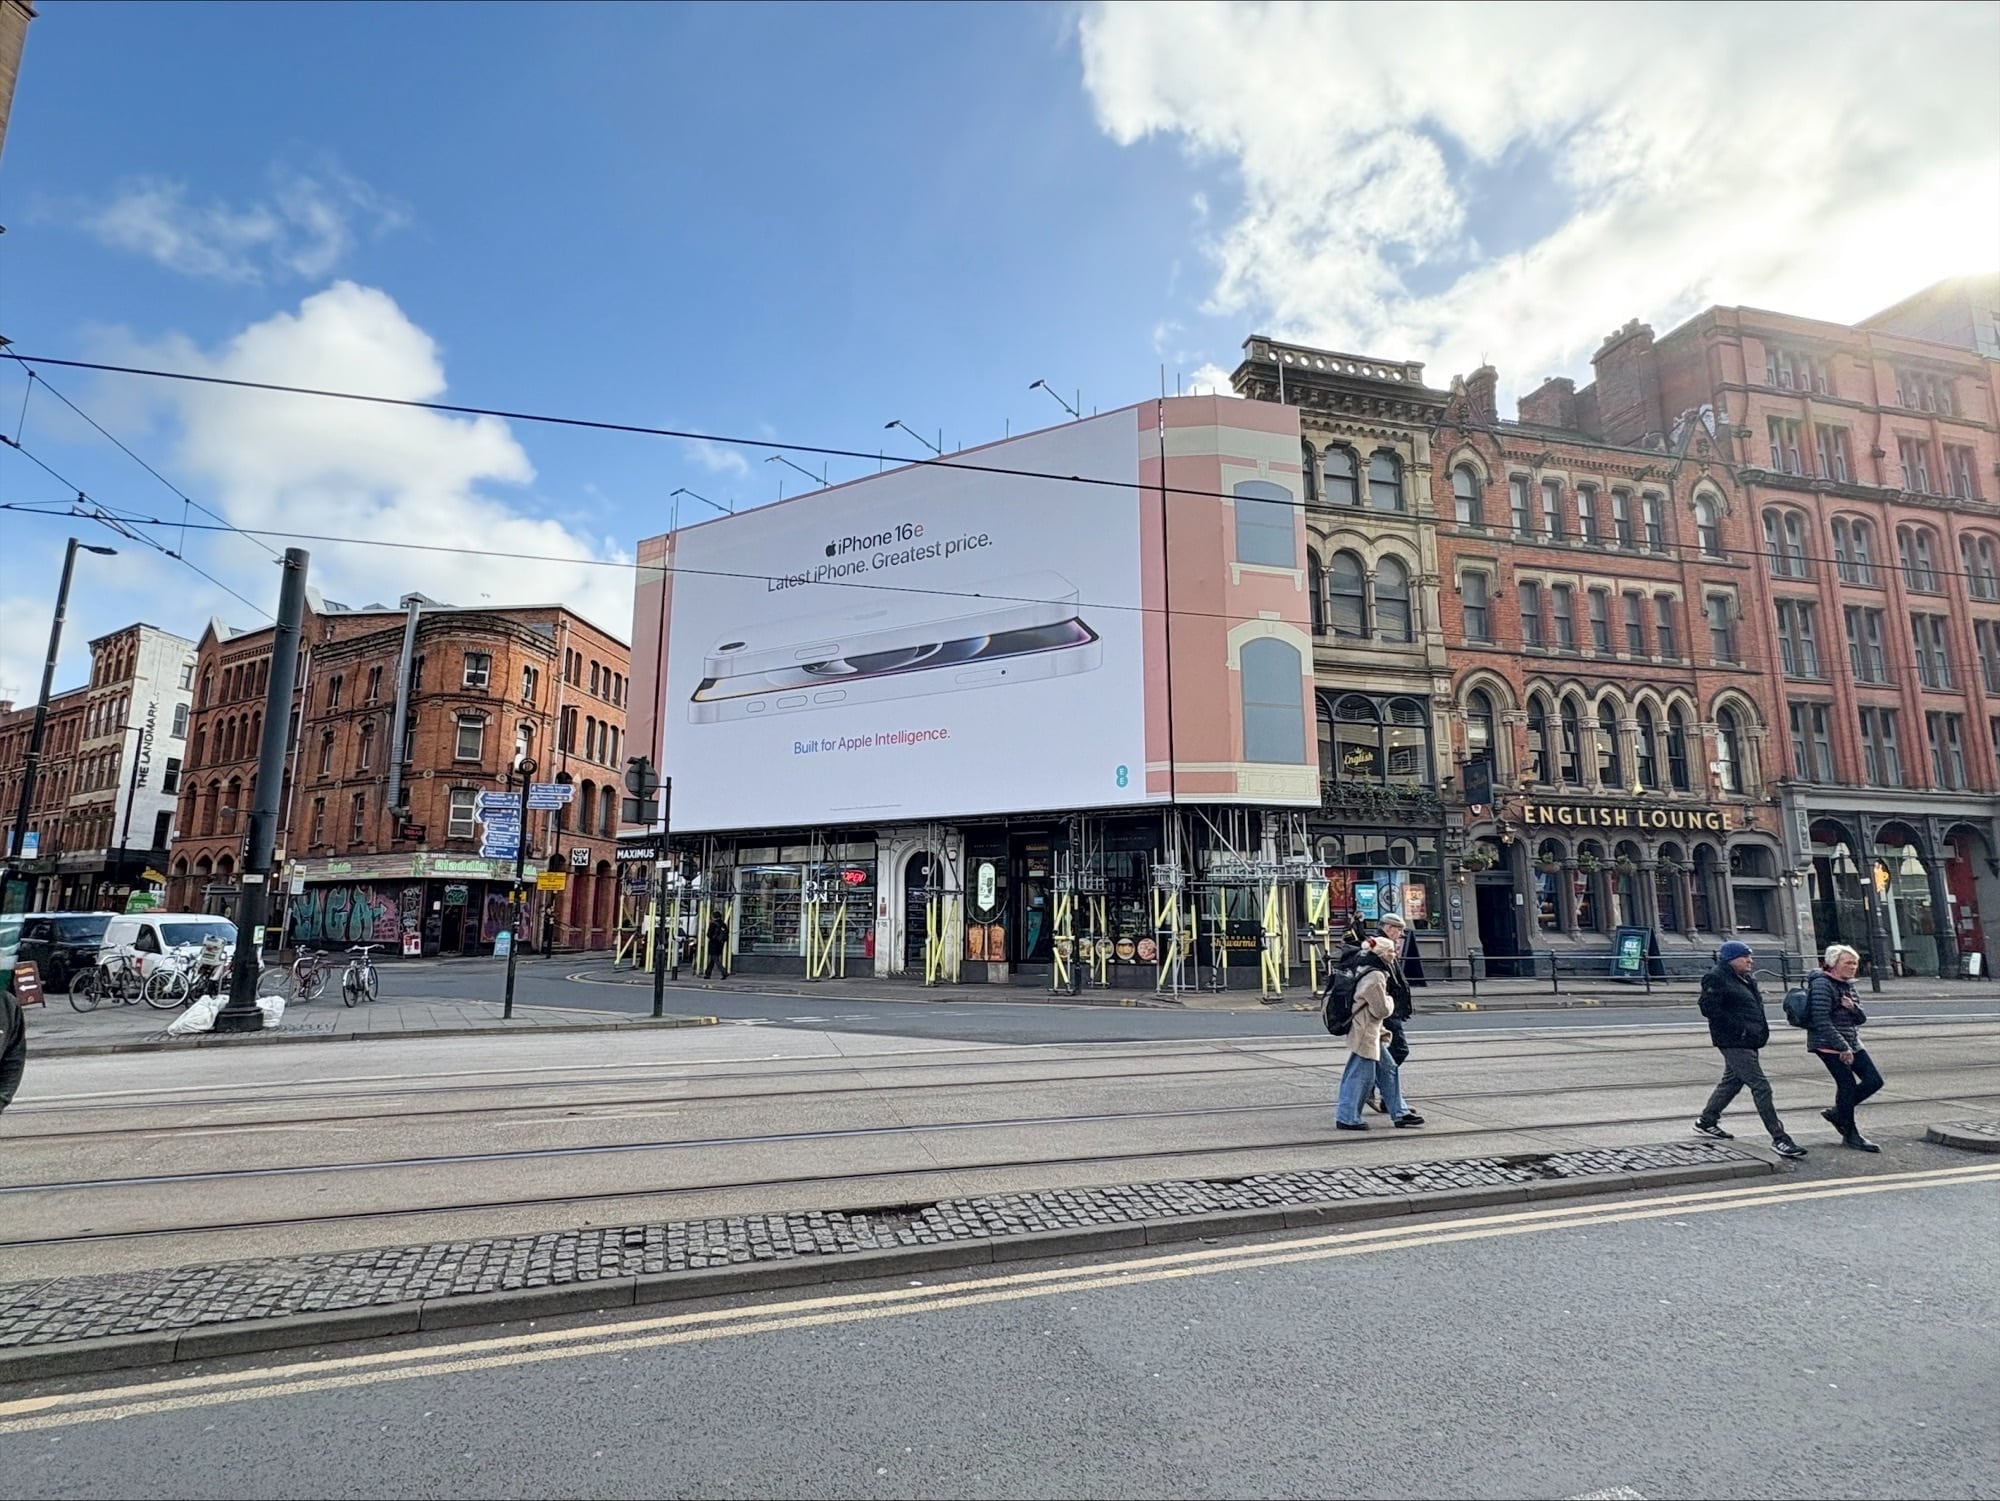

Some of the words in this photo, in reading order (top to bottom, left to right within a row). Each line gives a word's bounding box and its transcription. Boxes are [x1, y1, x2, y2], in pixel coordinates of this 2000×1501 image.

[838, 531, 892, 555] iPhone
[894, 523, 924, 542] 16e
[768, 569, 811, 592] Latest
[814, 560, 869, 583] iPhone.
[872, 540, 942, 569] Greatest
[945, 533, 993, 558] price.
[142, 701, 159, 764] LANDMARK
[794, 740, 818, 755] Built
[821, 738, 836, 751] for
[838, 735, 872, 752] Apple
[875, 728, 951, 746] Intelligence.
[1344, 751, 1374, 766] English
[136, 766, 149, 789] THE
[1524, 805, 1628, 827] ENGLISH
[1638, 809, 1734, 830] LOUNGE
[617, 848, 655, 860] MAXIMUS
[843, 872, 864, 883] OPEN
